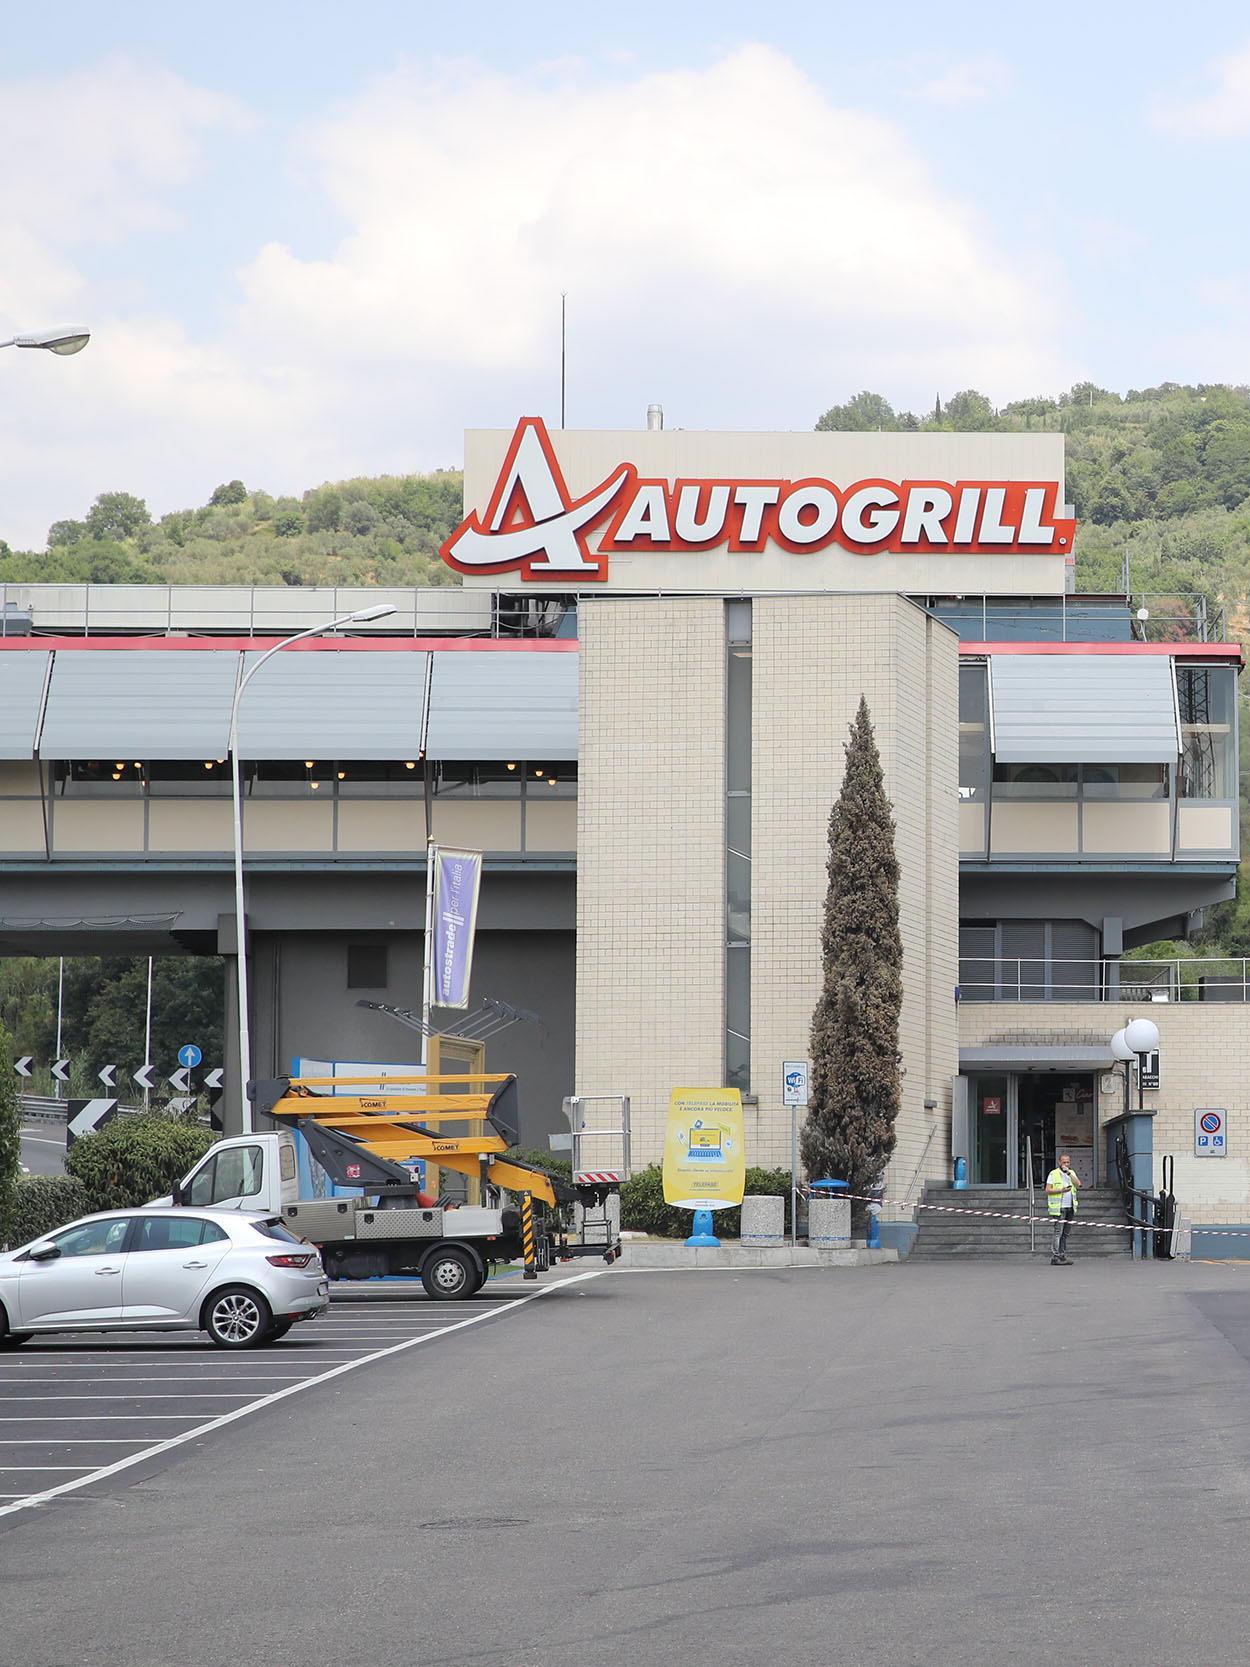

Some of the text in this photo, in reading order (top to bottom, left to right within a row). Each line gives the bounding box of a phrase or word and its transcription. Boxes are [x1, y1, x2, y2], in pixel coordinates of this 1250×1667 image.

[614, 485, 1055, 545] AUTOGRILL
[449, 895, 460, 915] per
[442, 924, 457, 997] autostrade
